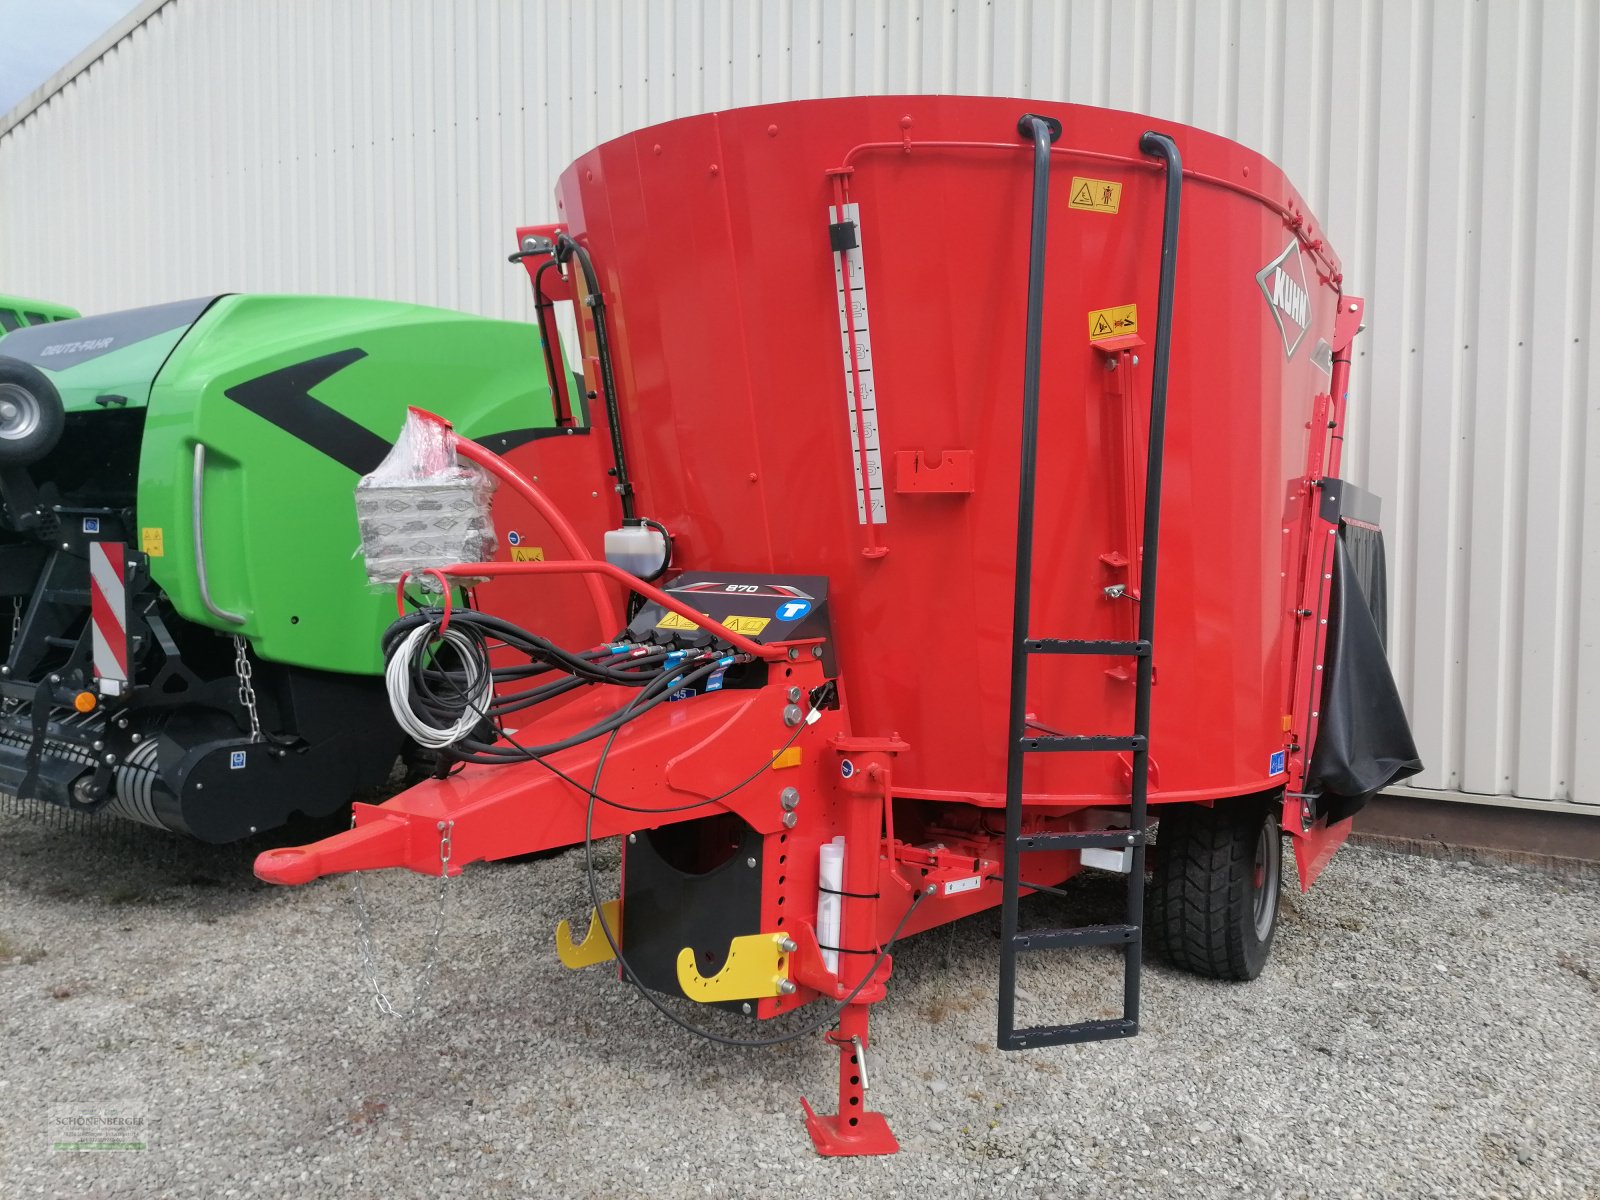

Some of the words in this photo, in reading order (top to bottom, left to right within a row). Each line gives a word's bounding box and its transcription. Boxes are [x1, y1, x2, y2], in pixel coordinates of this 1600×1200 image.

[1273, 266, 1307, 329] KUHN
[40, 336, 114, 357] DEUTZ-FAHR
[725, 584, 759, 593] 870
[673, 689, 687, 699] 45
